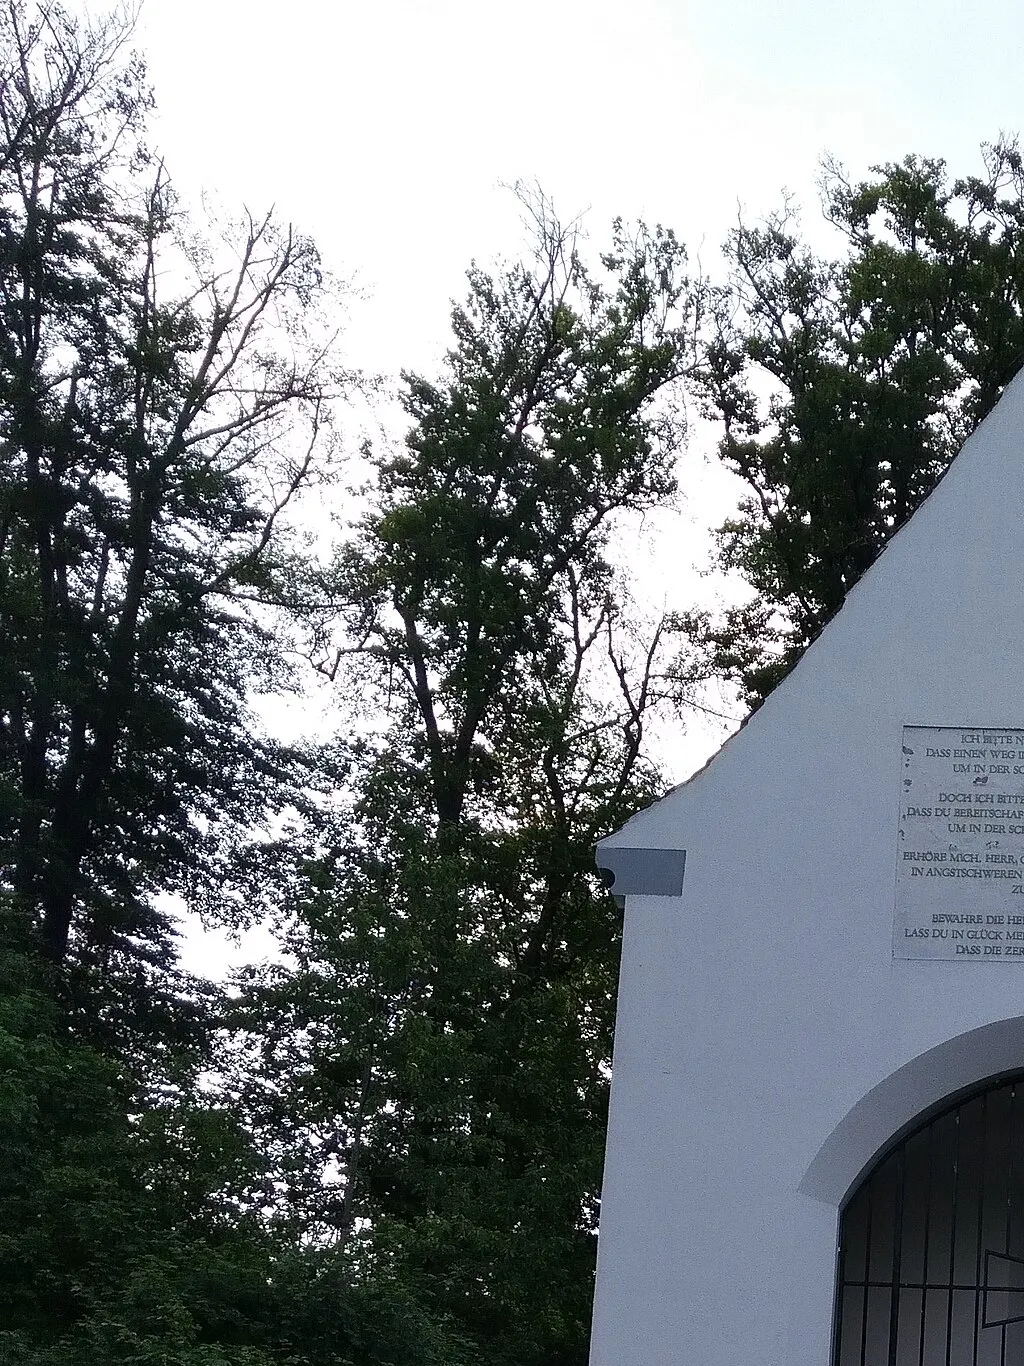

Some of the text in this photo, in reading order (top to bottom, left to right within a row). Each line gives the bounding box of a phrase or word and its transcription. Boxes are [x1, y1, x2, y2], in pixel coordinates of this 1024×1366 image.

[961, 733, 980, 744] ICH
[983, 734, 1012, 744] BITTE
[926, 747, 951, 758] DASS
[954, 748, 986, 759] EINEN
[990, 749, 1016, 759] WEG
[953, 763, 972, 773] UM
[972, 764, 987, 773] IN
[987, 764, 1010, 774] DER
[939, 792, 973, 803] DOCH
[974, 794, 994, 804] ICH
[906, 807, 932, 817] DASS
[935, 807, 950, 817] DU
[948, 823, 968, 833] UM
[968, 823, 980, 833] IN
[984, 824, 1006, 834] DER
[903, 850, 946, 862] ERHÖRE
[985, 853, 1018, 866] HERR,
[910, 867, 925, 876] IN
[926, 867, 1022, 879] ANGSTSCHWEREN
[932, 913, 983, 924] BEWAHRE
[986, 914, 1004, 925] DIE
[905, 927, 929, 938] LASS
[932, 928, 948, 938] DU
[952, 928, 964, 939] IN
[967, 927, 1003, 940] GLÜCK
[956, 944, 981, 954] DASS
[984, 945, 1002, 955] DIE
